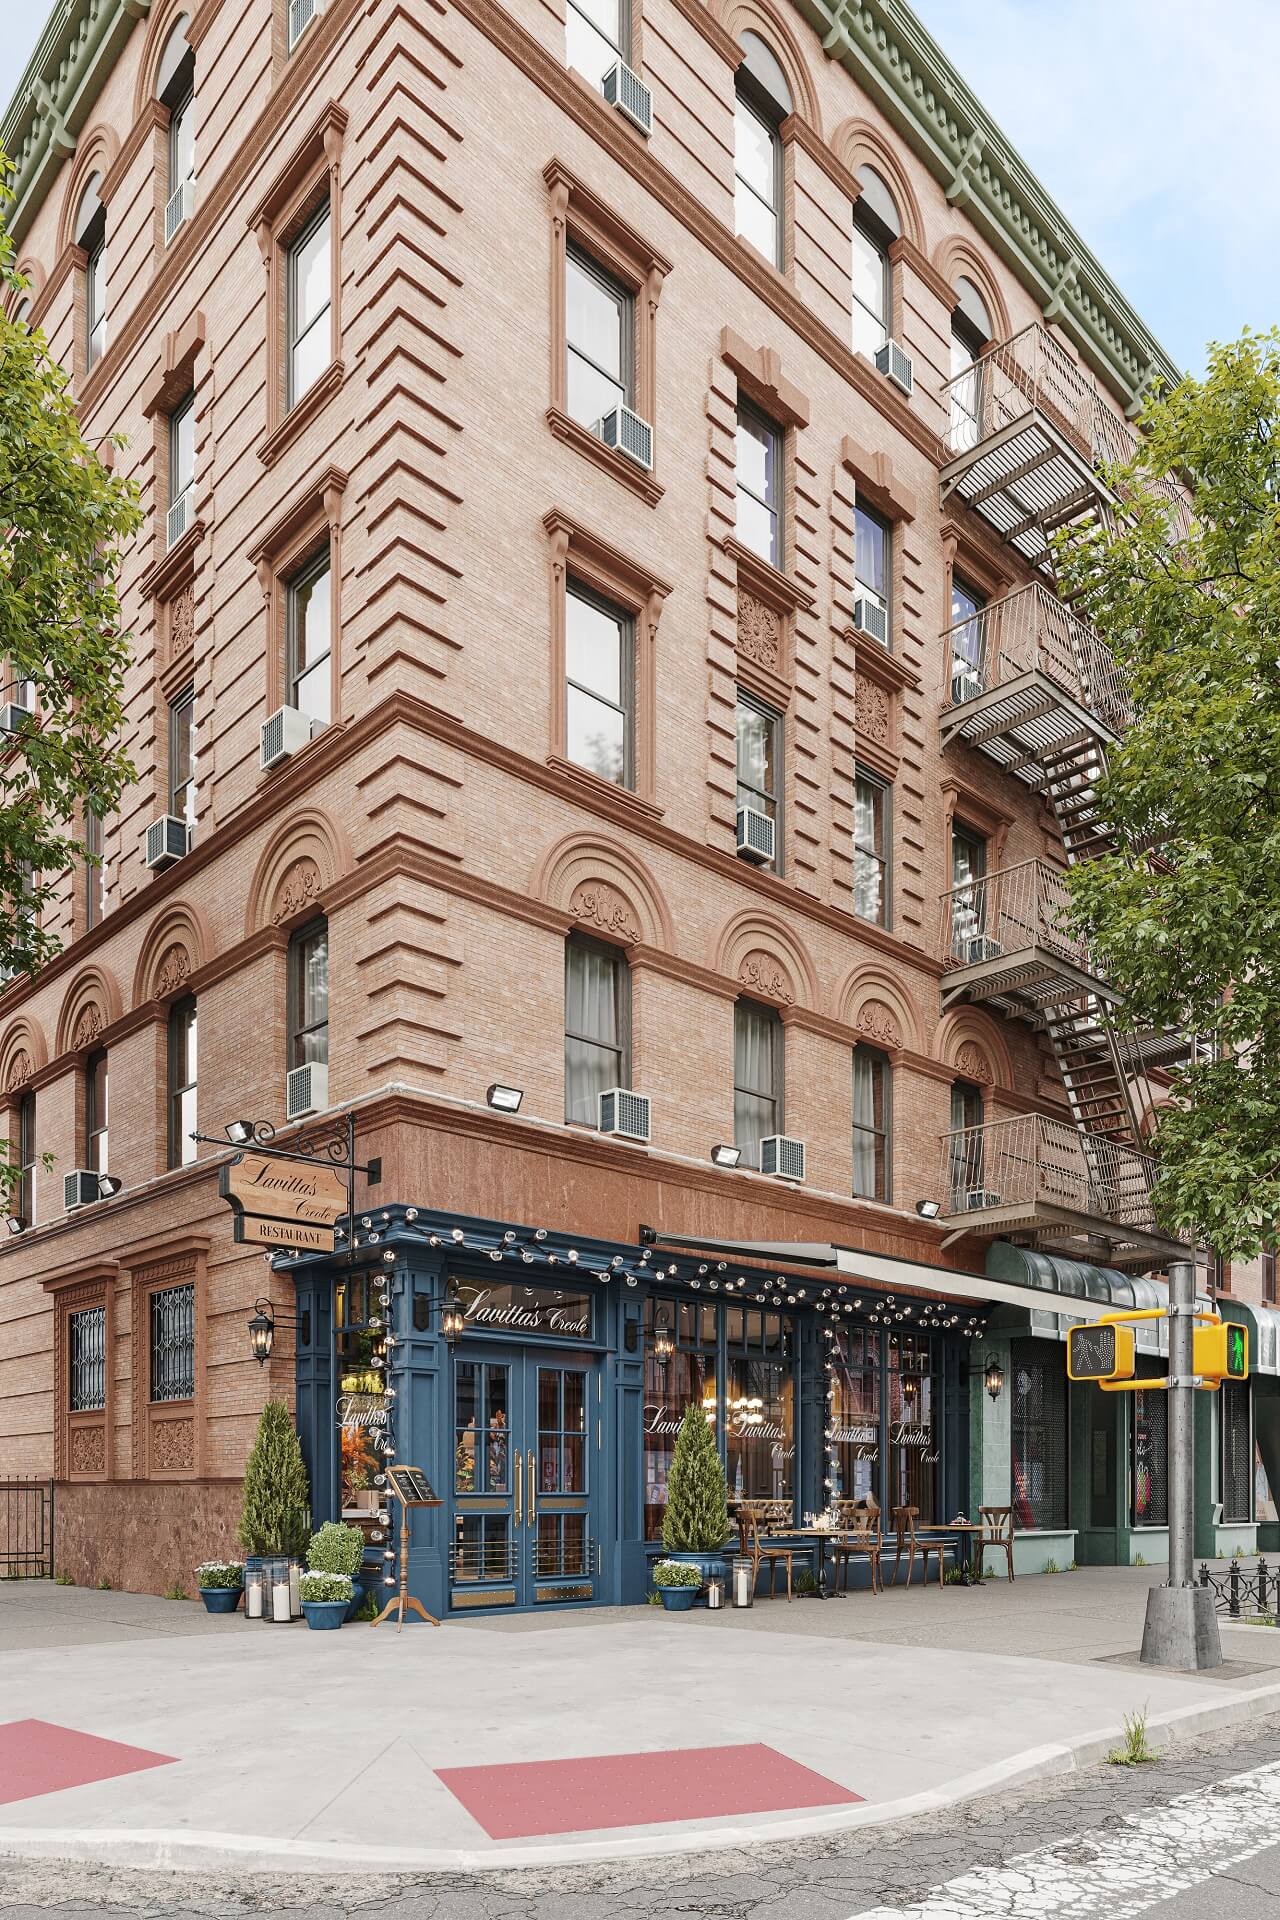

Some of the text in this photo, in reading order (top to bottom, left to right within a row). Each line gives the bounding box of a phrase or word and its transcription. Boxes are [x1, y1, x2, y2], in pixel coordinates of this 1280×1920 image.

[294, 1198, 332, 1220] Creole
[260, 1224, 322, 1244] RESTAURANT
[546, 1308, 588, 1332] Creole
[643, 1405, 686, 1434] Lavit
[855, 1444, 879, 1462] Creole
[919, 1448, 940, 1463] Creole
